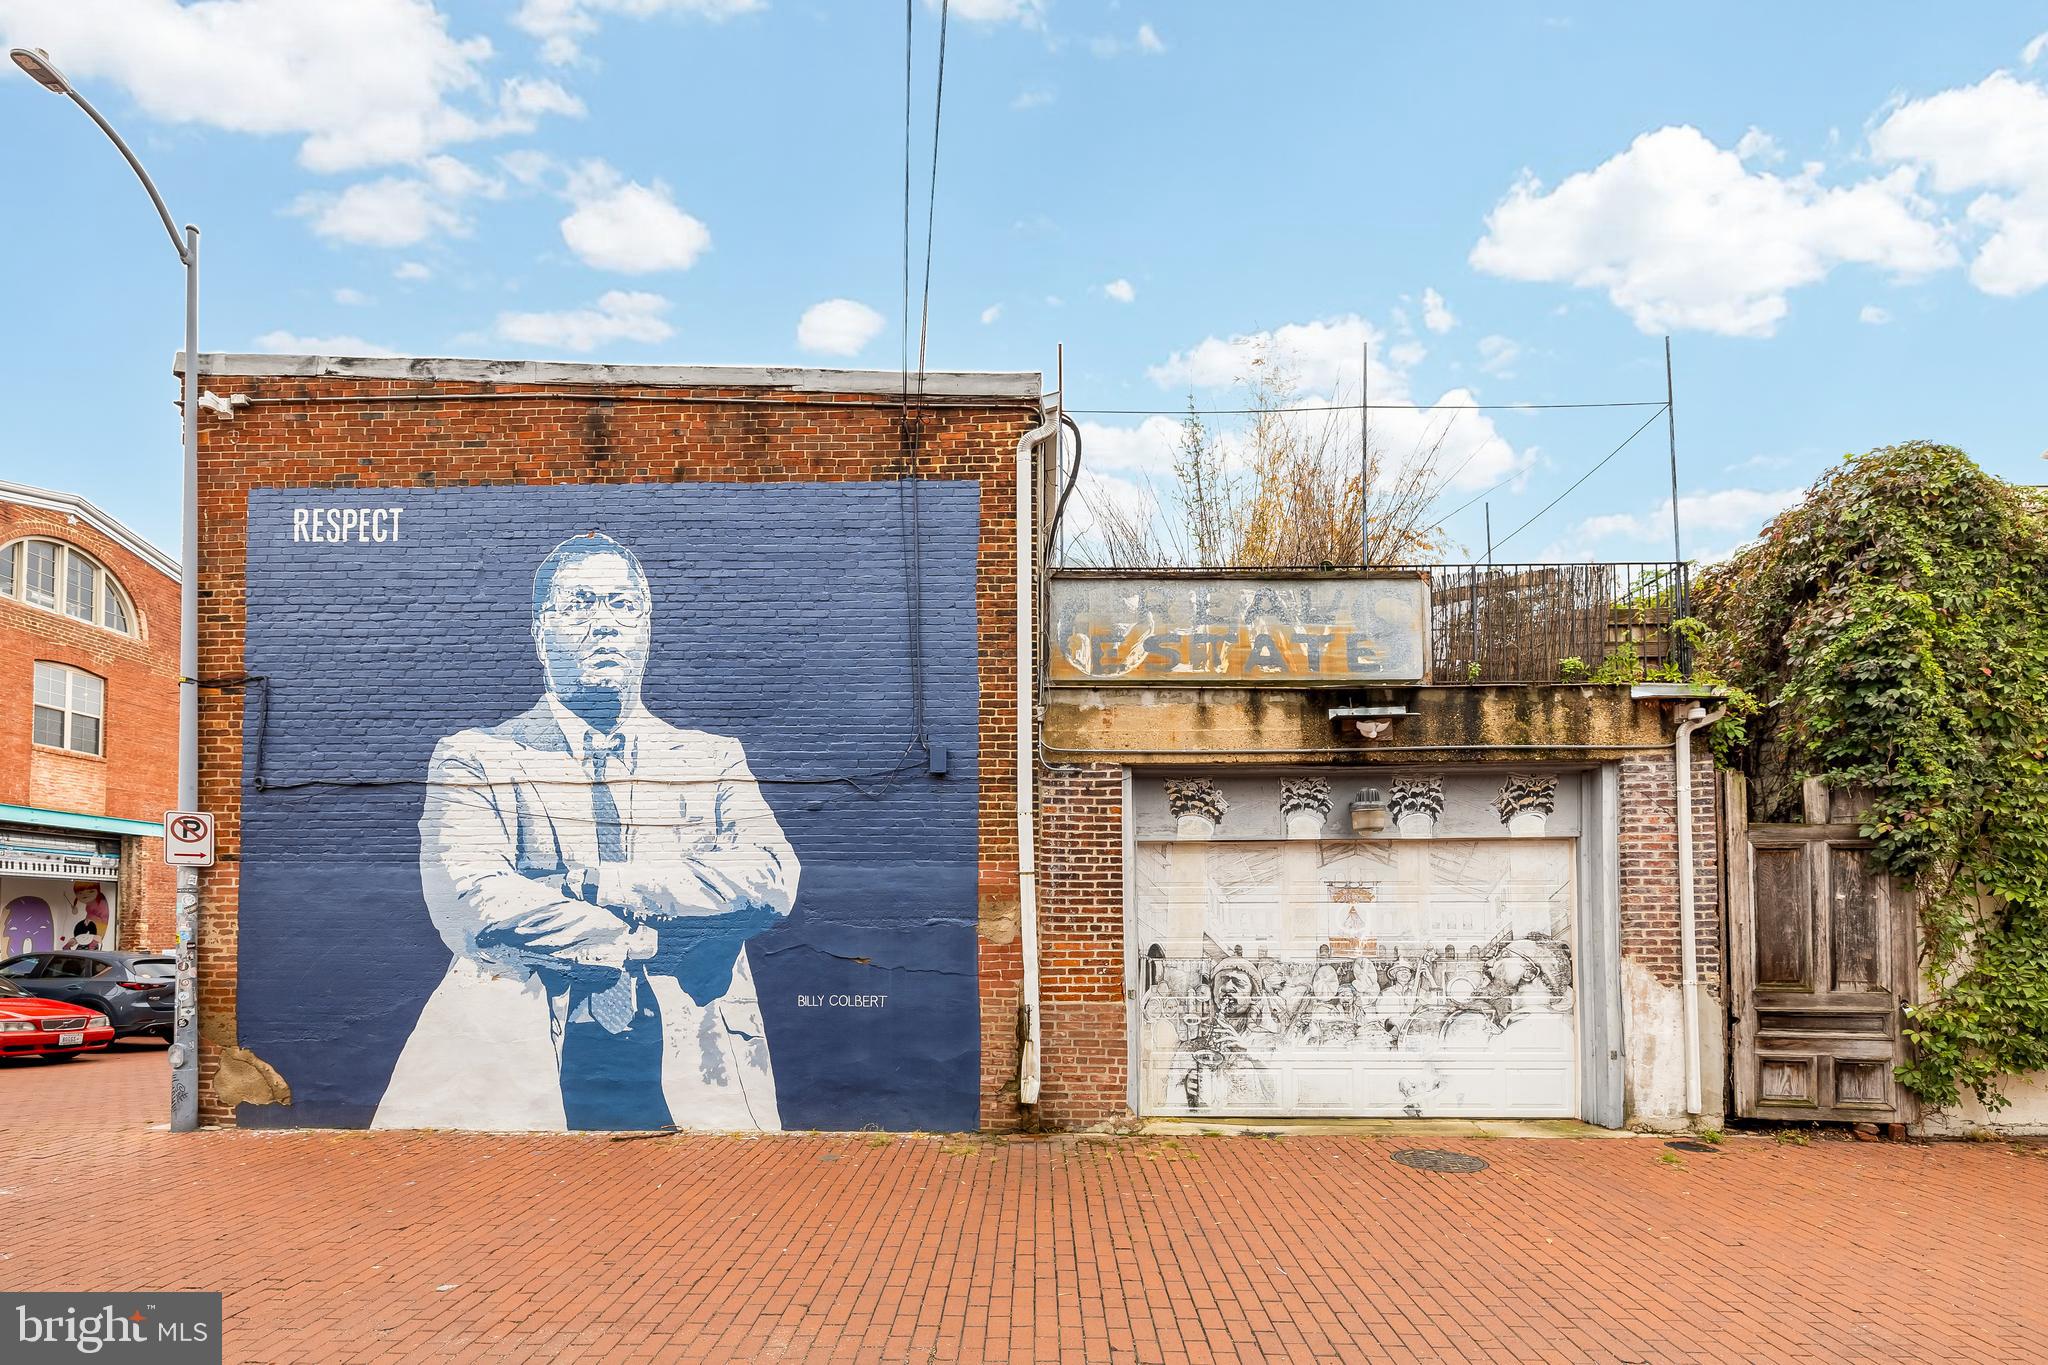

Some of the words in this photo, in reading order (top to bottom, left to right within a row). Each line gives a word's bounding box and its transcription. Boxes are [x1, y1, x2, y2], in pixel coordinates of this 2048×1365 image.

[293, 507, 404, 543] RESPECT
[1090, 631, 1385, 676] ESTATE
[797, 994, 825, 1007] BILLY
[828, 994, 888, 1008] COLBERT
